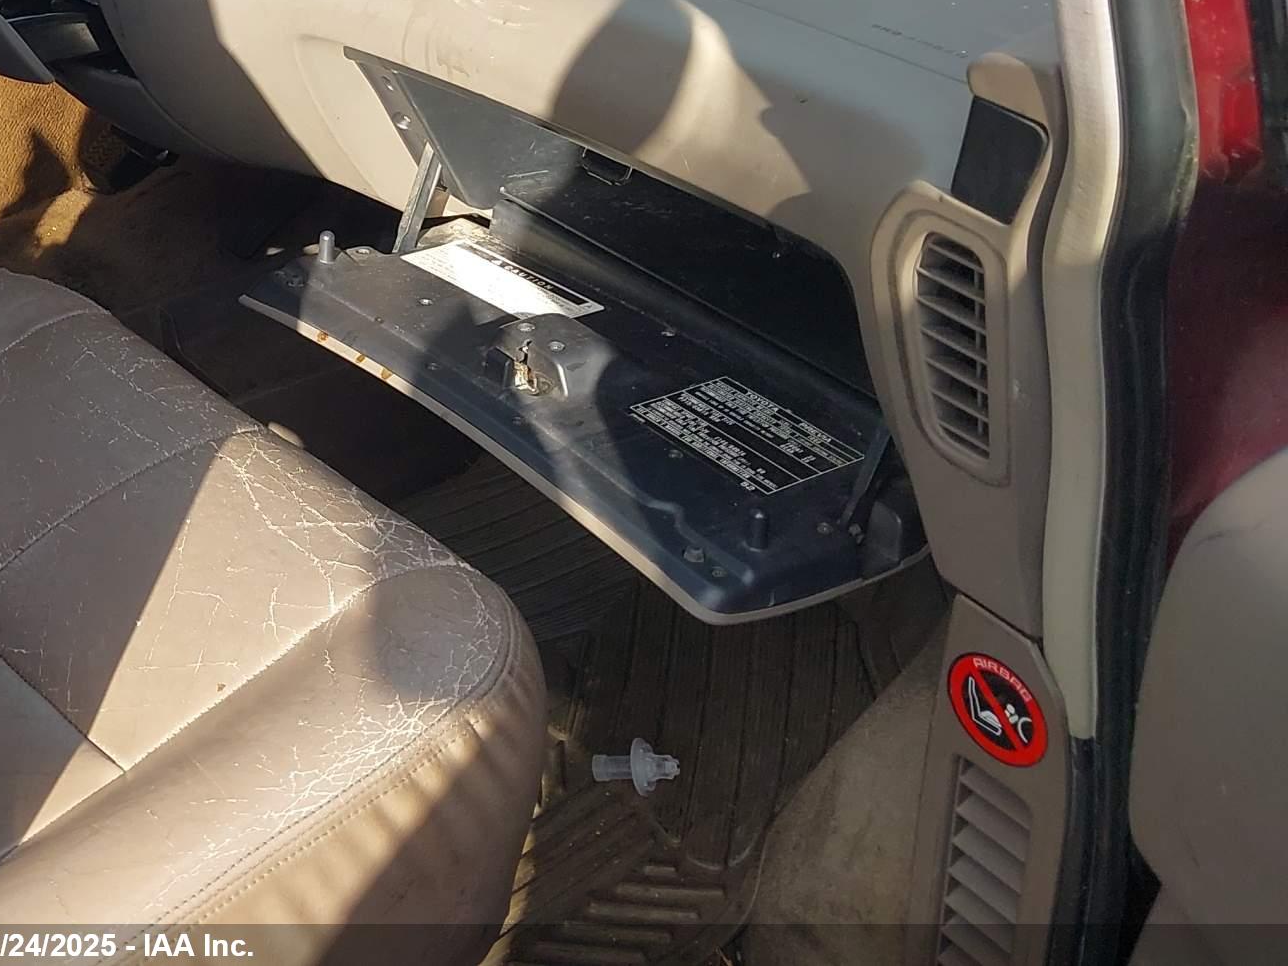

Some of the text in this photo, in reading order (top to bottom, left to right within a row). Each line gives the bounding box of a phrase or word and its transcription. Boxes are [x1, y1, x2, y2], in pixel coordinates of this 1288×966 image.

[503, 264, 555, 290] CAUTION
[746, 390, 780, 413] TOYOTA
[973, 657, 1033, 703] AIRBAG
